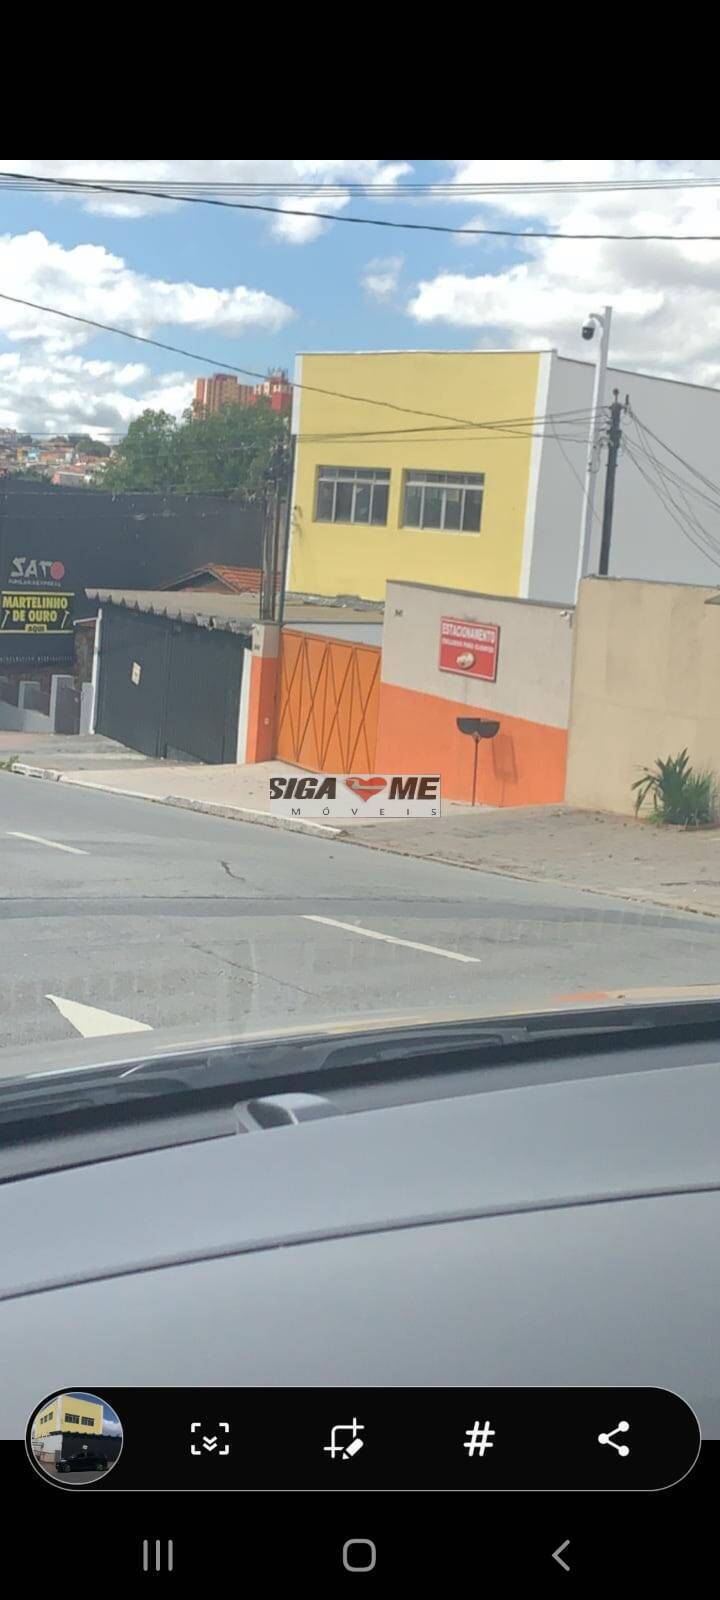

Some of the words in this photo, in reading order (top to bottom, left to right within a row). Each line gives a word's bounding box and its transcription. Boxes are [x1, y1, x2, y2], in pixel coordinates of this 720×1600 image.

[2, 596, 68, 609] MARTELINHO
[12, 610, 26, 622] DE
[28, 610, 58, 622] OURO
